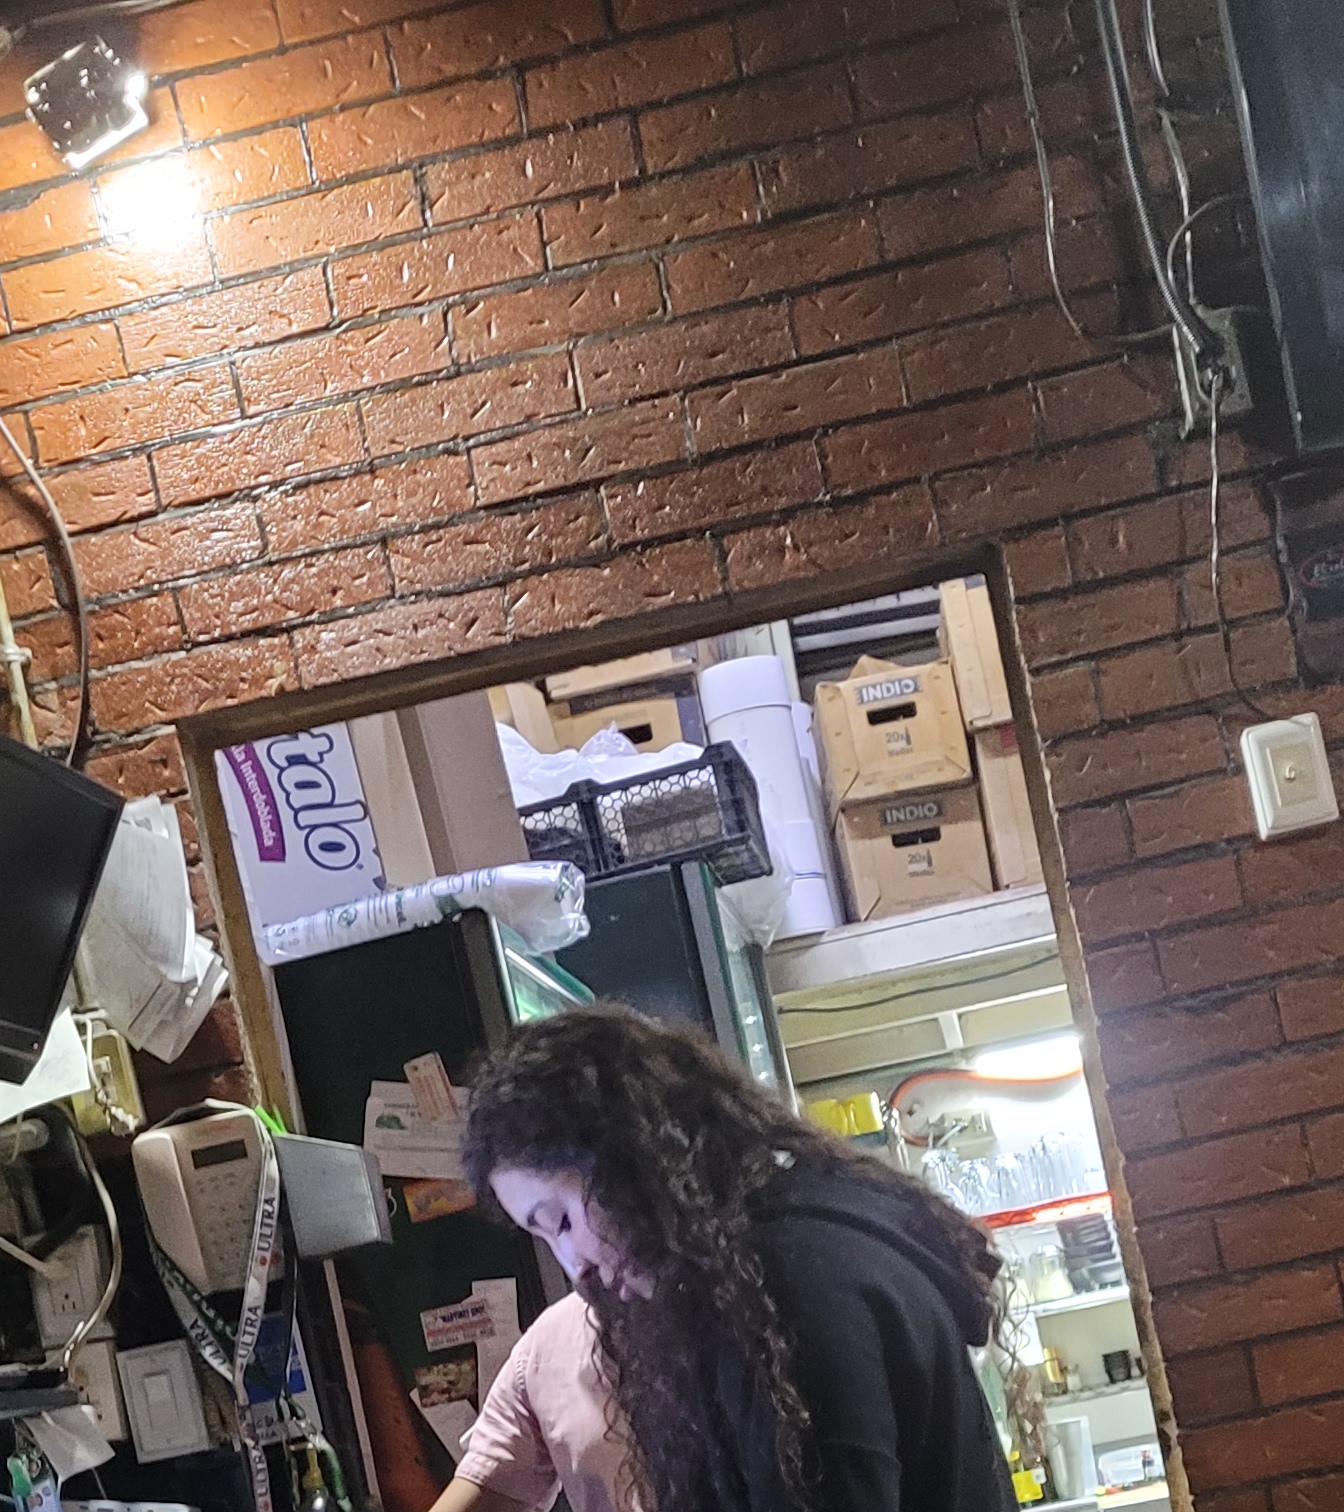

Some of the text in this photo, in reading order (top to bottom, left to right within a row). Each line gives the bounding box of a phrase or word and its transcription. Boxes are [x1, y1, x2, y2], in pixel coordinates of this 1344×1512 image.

[859, 677, 916, 703] INDIO
[239, 756, 276, 848] Interdoblada
[884, 801, 940, 825] INDIO
[256, 1197, 277, 1254] ULTRA
[188, 1317, 227, 1368] ULTRA
[237, 1303, 262, 1360] ULTRA
